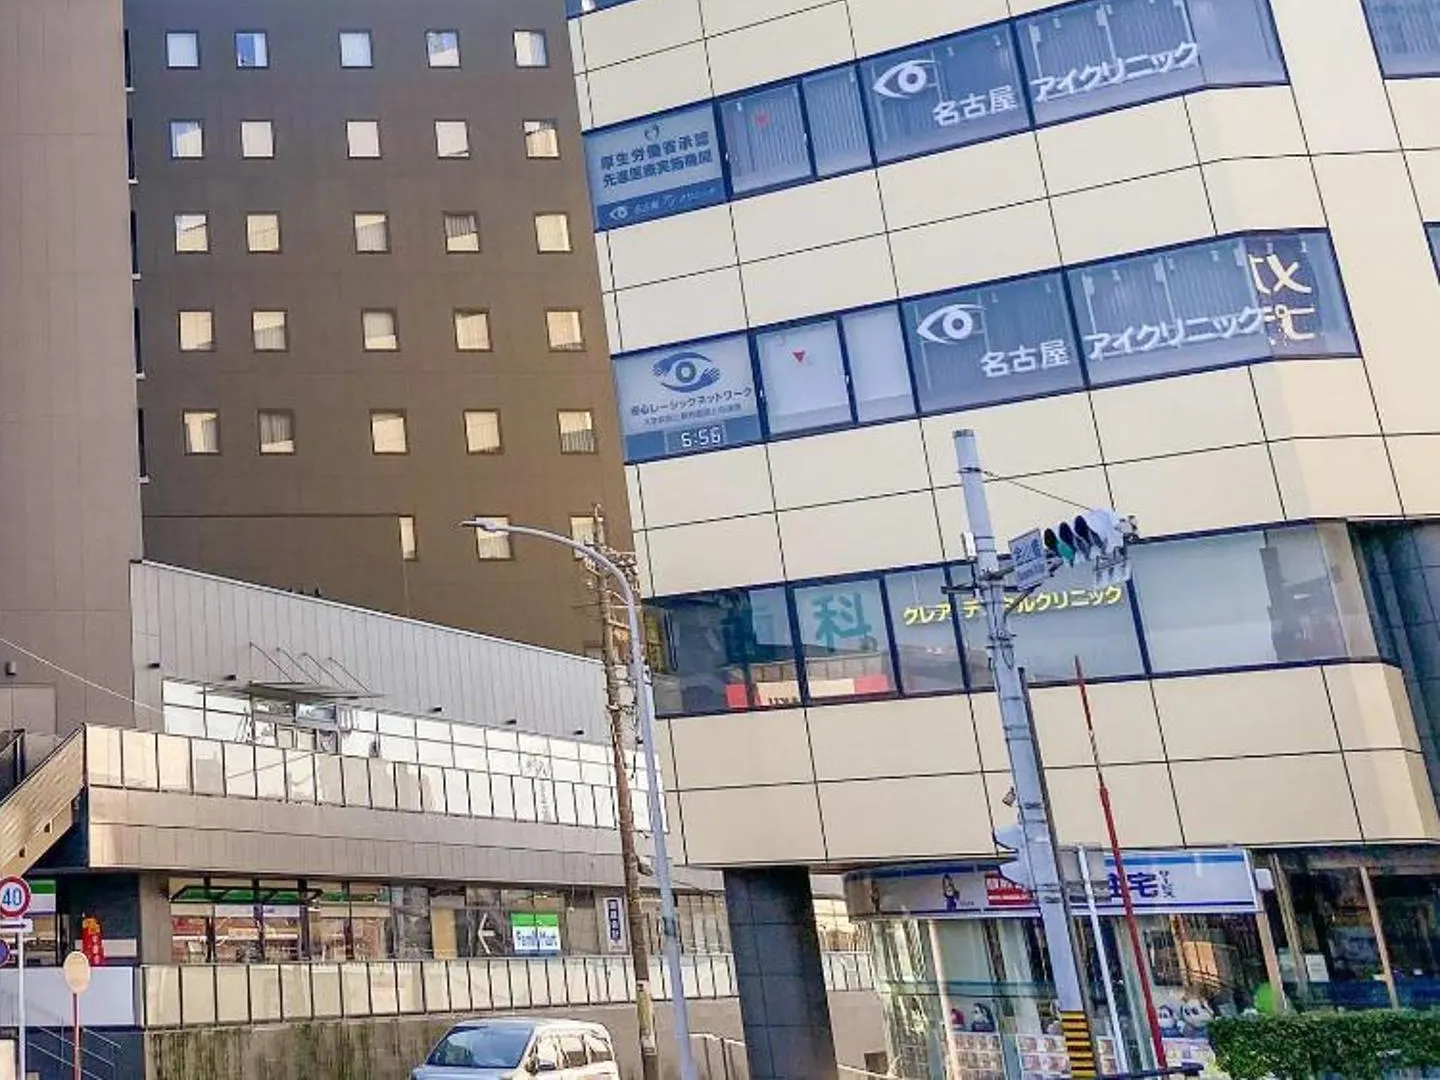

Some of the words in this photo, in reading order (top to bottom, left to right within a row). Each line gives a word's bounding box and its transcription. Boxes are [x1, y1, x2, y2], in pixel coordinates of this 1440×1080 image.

[932, 85, 1017, 126] 名古屋
[1030, 42, 1198, 102] アイクリニック
[980, 340, 1071, 378] 名古屋
[1083, 305, 1265, 360] アイクリニック
[680, 426, 721, 448] 6:56
[2, 888, 22, 906] 40
